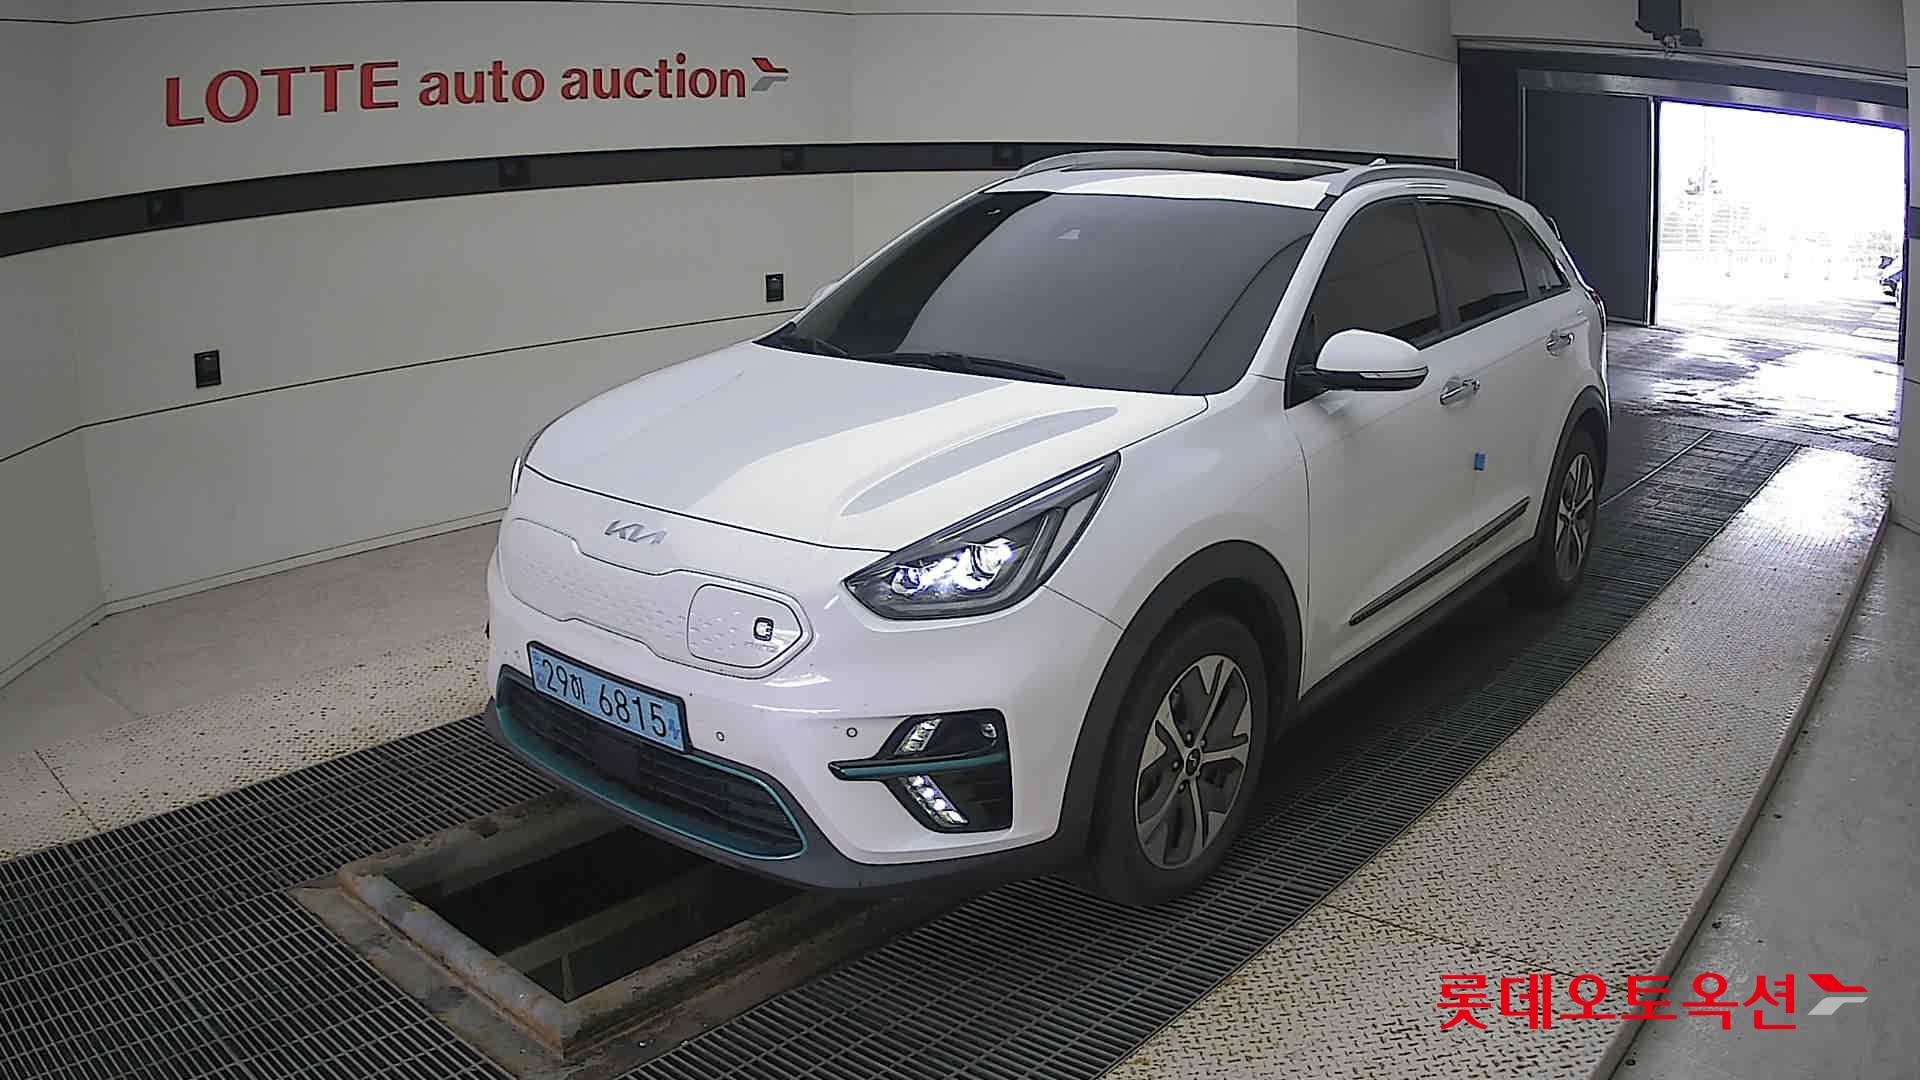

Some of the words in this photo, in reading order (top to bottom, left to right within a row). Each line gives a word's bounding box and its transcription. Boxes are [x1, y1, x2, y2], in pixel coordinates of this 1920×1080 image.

[165, 61, 399, 127] LOTTE
[418, 60, 546, 106] auto
[560, 53, 746, 99] auction
[604, 519, 668, 545] KIA
[599, 683, 667, 738] 6815
